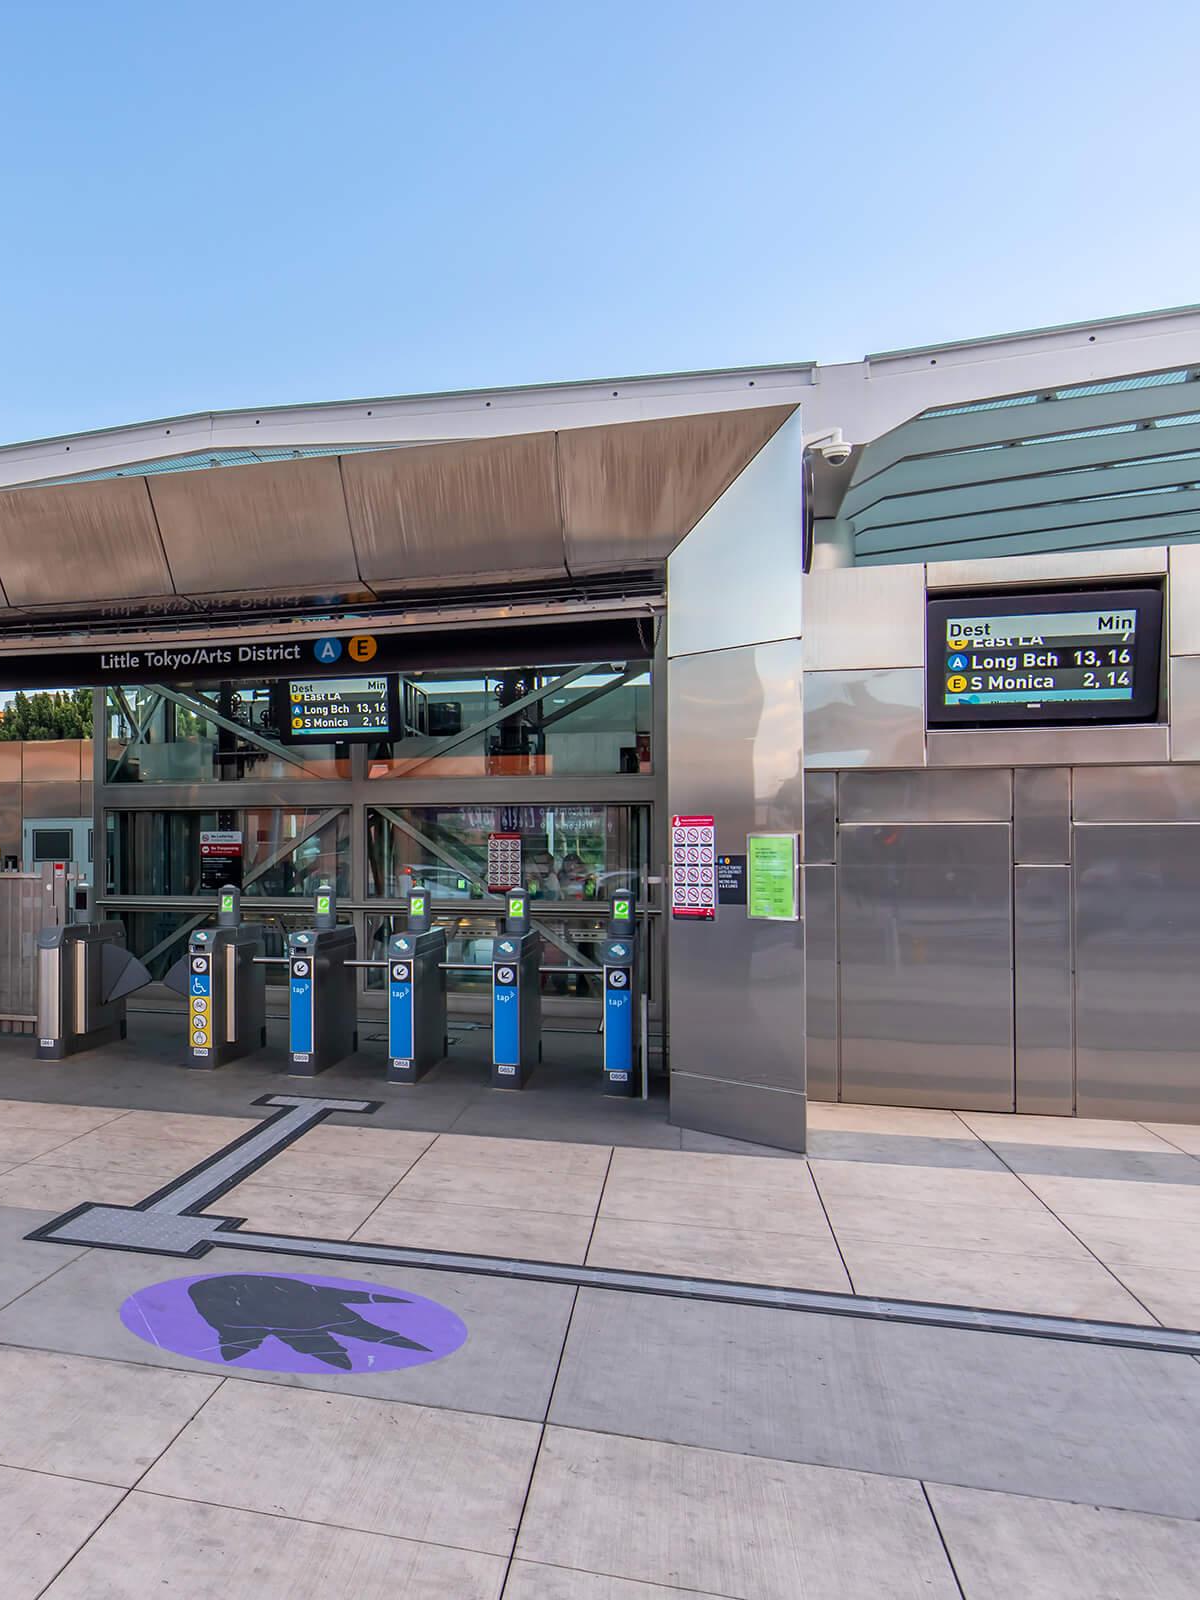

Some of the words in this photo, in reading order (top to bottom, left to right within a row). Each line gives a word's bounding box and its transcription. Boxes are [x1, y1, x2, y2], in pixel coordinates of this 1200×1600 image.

[950, 622, 991, 637] Dest
[1098, 616, 1132, 630] Min
[101, 651, 139, 669] Little
[144, 648, 232, 670] Tokyo/Arts
[238, 644, 301, 663] District
[321, 641, 336, 659] A
[357, 639, 370, 656] E
[972, 655, 1018, 671] Long
[1023, 652, 1058, 668] Bch
[1073, 651, 1100, 667] 13,
[1108, 649, 1131, 664] 16
[971, 677, 983, 690] S
[988, 674, 1054, 690] Monica
[1083, 673, 1100, 688] 2,
[1107, 671, 1130, 686] 14
[292, 684, 313, 693] Dest
[368, 681, 386, 690] Min
[304, 693, 326, 701] East
[304, 705, 328, 715] Long
[331, 704, 350, 713] Bch
[357, 703, 372, 714] 13,
[374, 702, 386, 712] 16
[304, 718, 312, 727] S
[314, 717, 349, 727] Monica
[363, 716, 373, 727] 2,
[374, 716, 387, 726] 14
[292, 986, 305, 995] tap
[392, 991, 405, 999] tap
[496, 994, 510, 1003] tap
[608, 999, 623, 1008] tap
[499, 1066, 514, 1074] 0857
